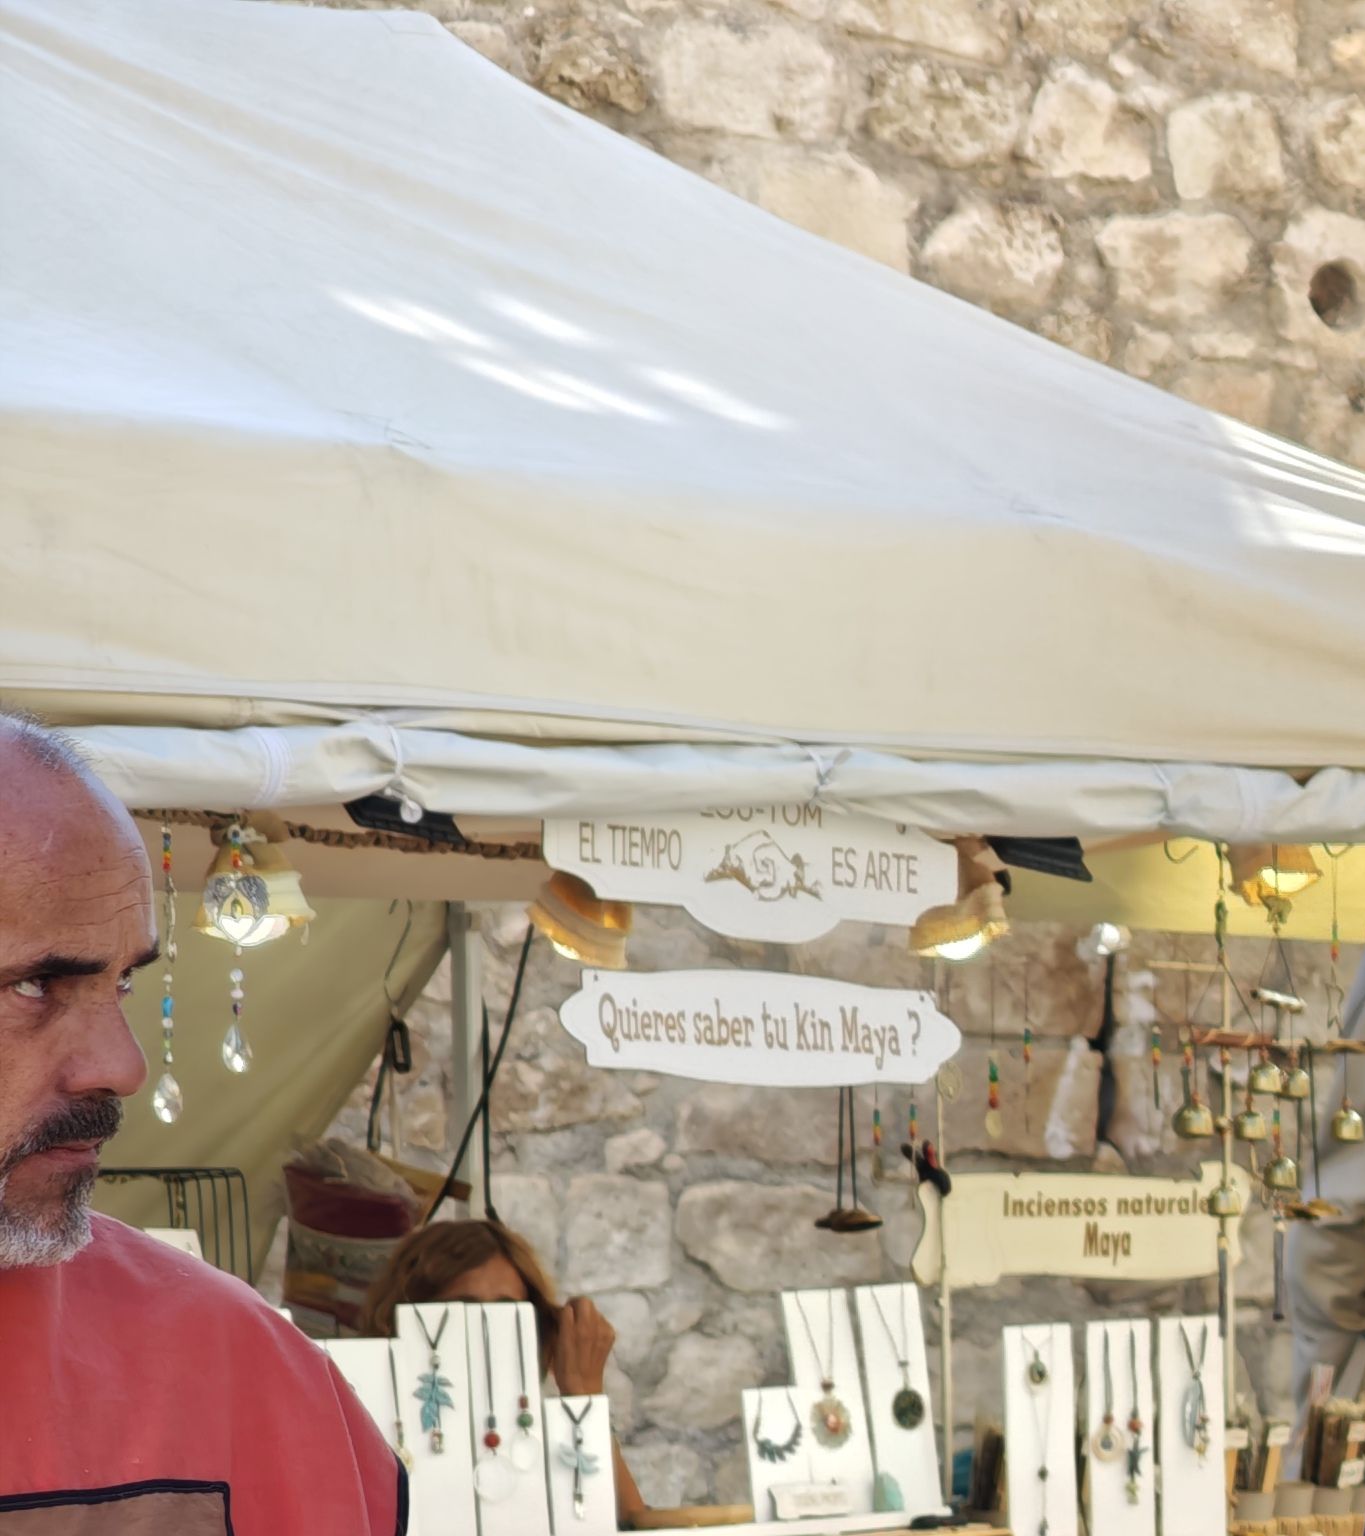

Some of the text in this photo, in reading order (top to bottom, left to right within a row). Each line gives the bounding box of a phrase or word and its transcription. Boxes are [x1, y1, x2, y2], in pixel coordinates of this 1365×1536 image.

[578, 821, 919, 895] EL TIEMPO ES ARTE
[598, 992, 687, 1053] Quieres
[693, 998, 755, 1048] saber
[761, 1001, 789, 1051] tu
[838, 1005, 902, 1070] Maya
[906, 1008, 922, 1056] ?
[1002, 1187, 1211, 1218] Inciensos naturale
[1082, 1221, 1132, 1266] Maya
